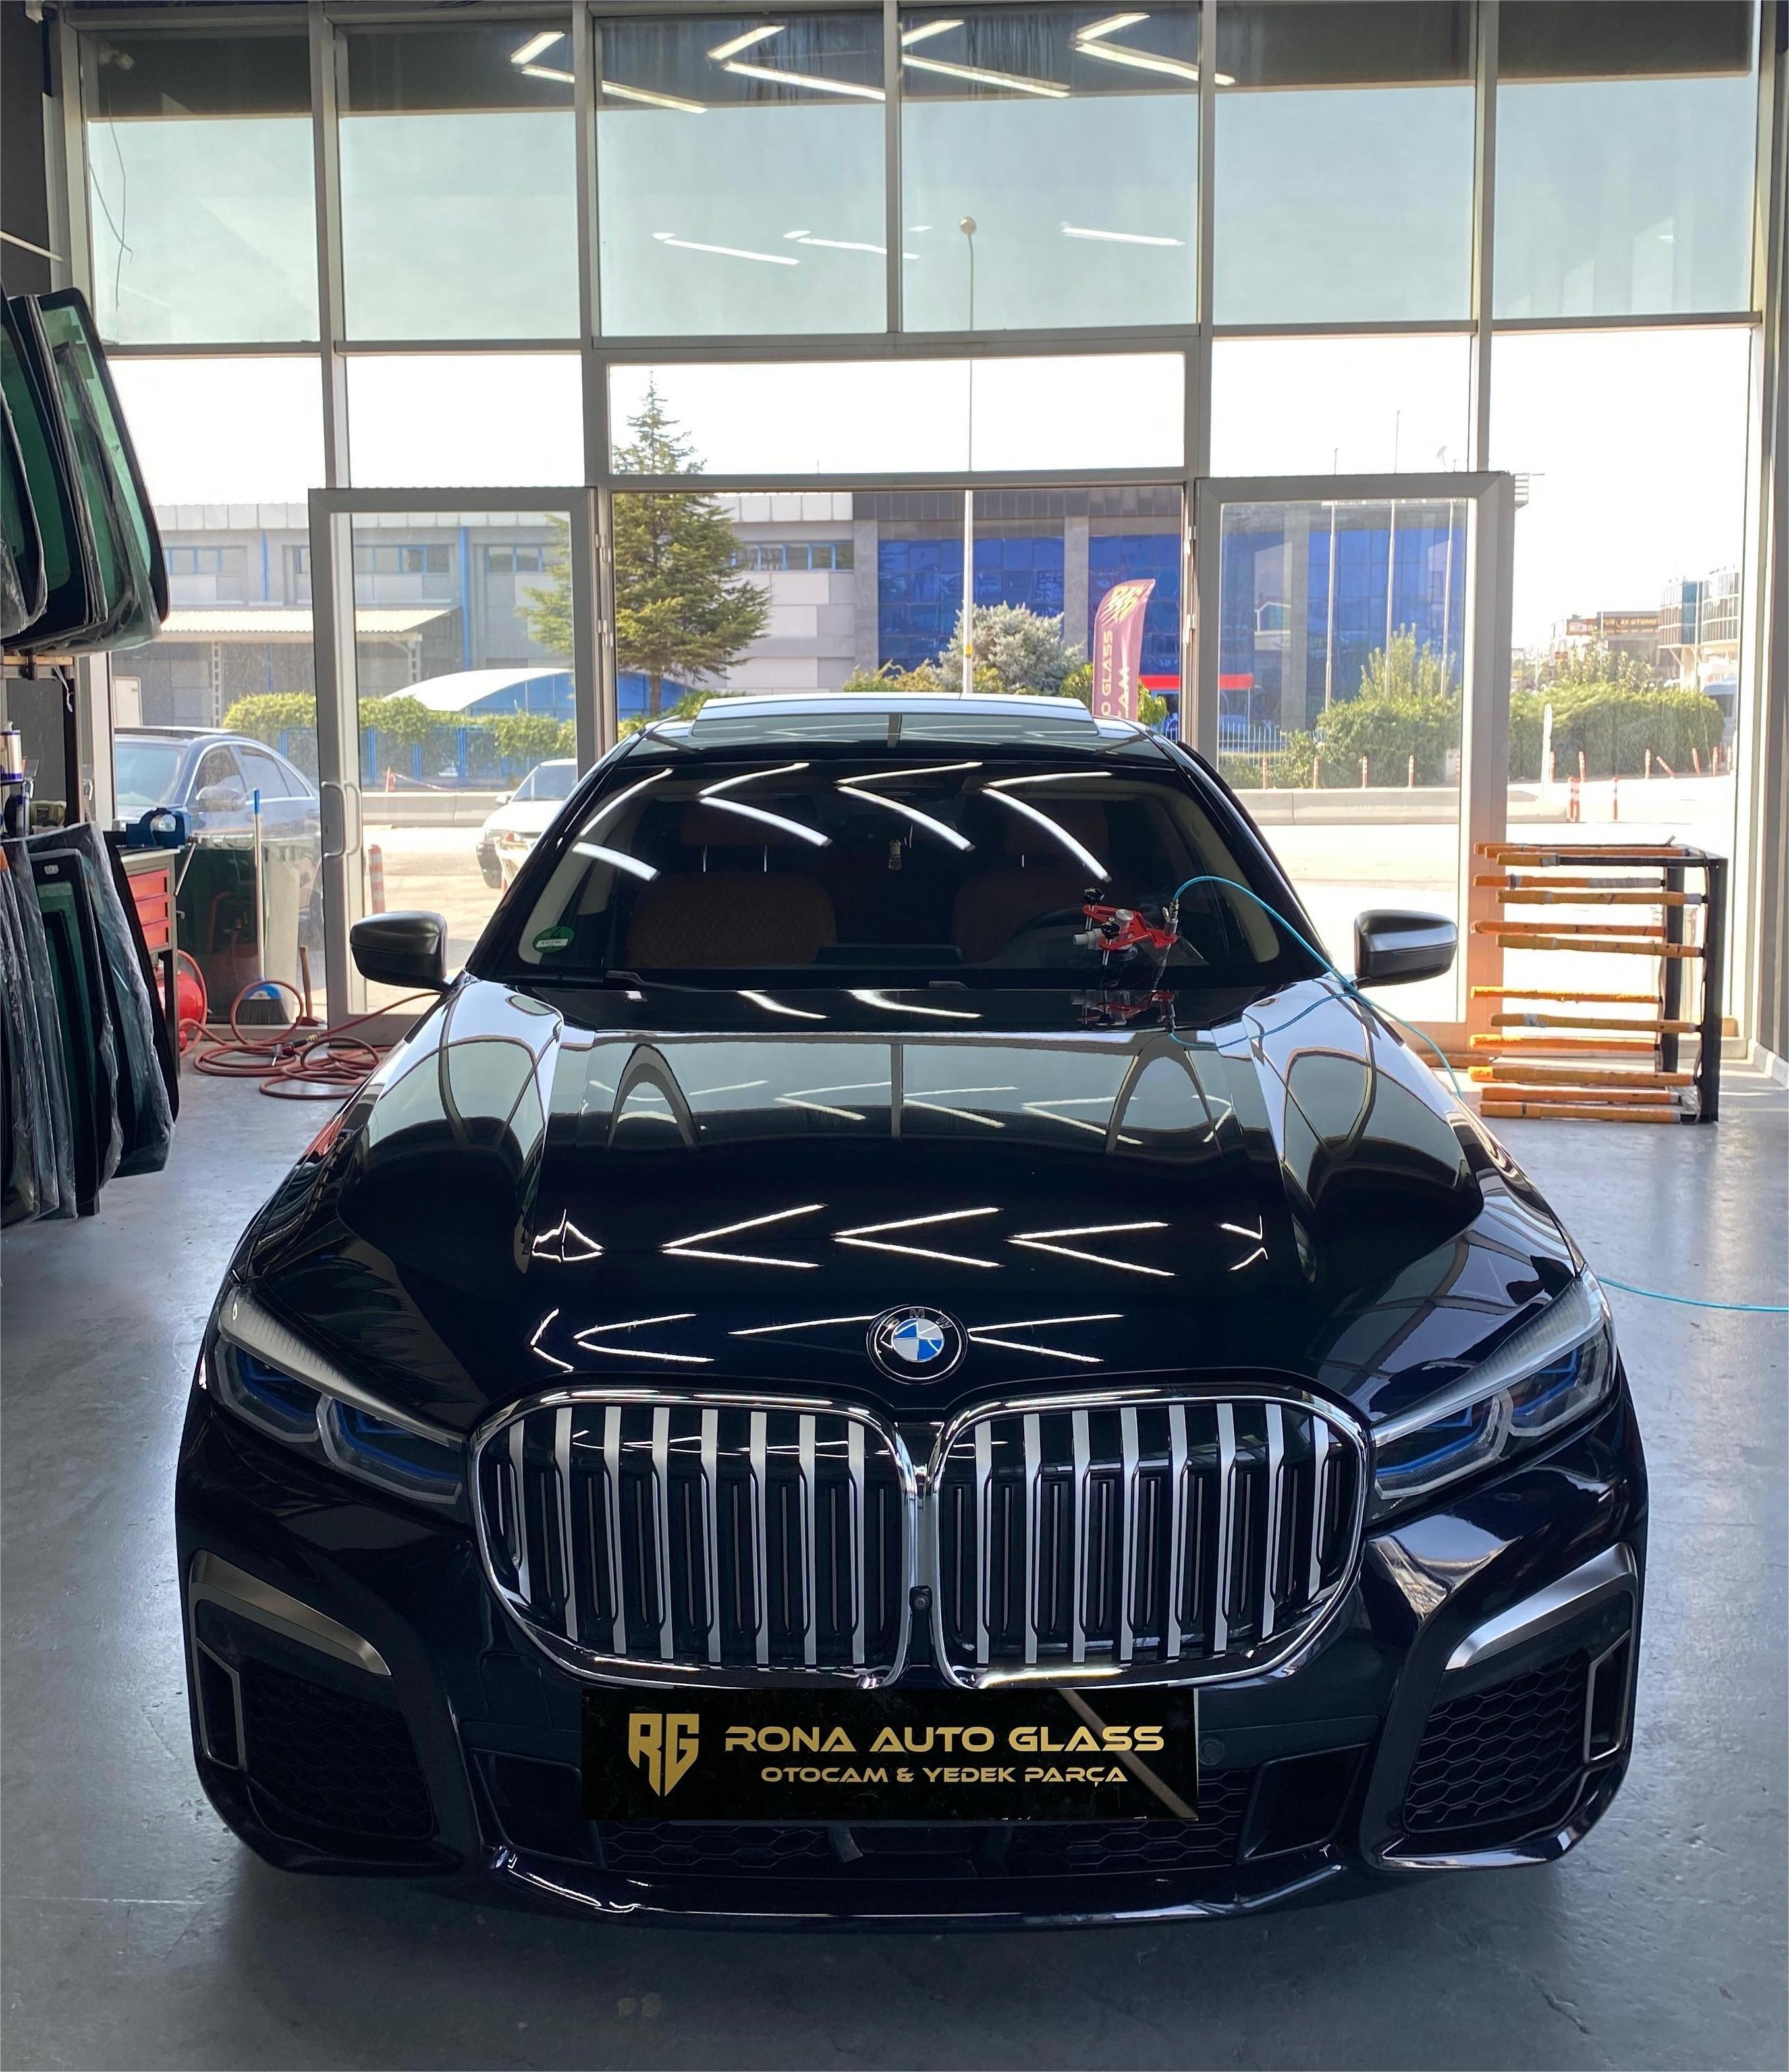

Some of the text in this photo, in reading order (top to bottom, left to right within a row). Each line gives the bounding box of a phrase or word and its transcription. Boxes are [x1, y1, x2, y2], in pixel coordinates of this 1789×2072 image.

[1101, 630, 1113, 696] GLASS
[883, 1308, 952, 1329] BMW
[725, 1725, 1165, 1752] RONA AUTO GLASS
[628, 1713, 700, 1796] RG
[760, 1766, 1128, 1787] OTOCAM & YEDEK PARÇA
